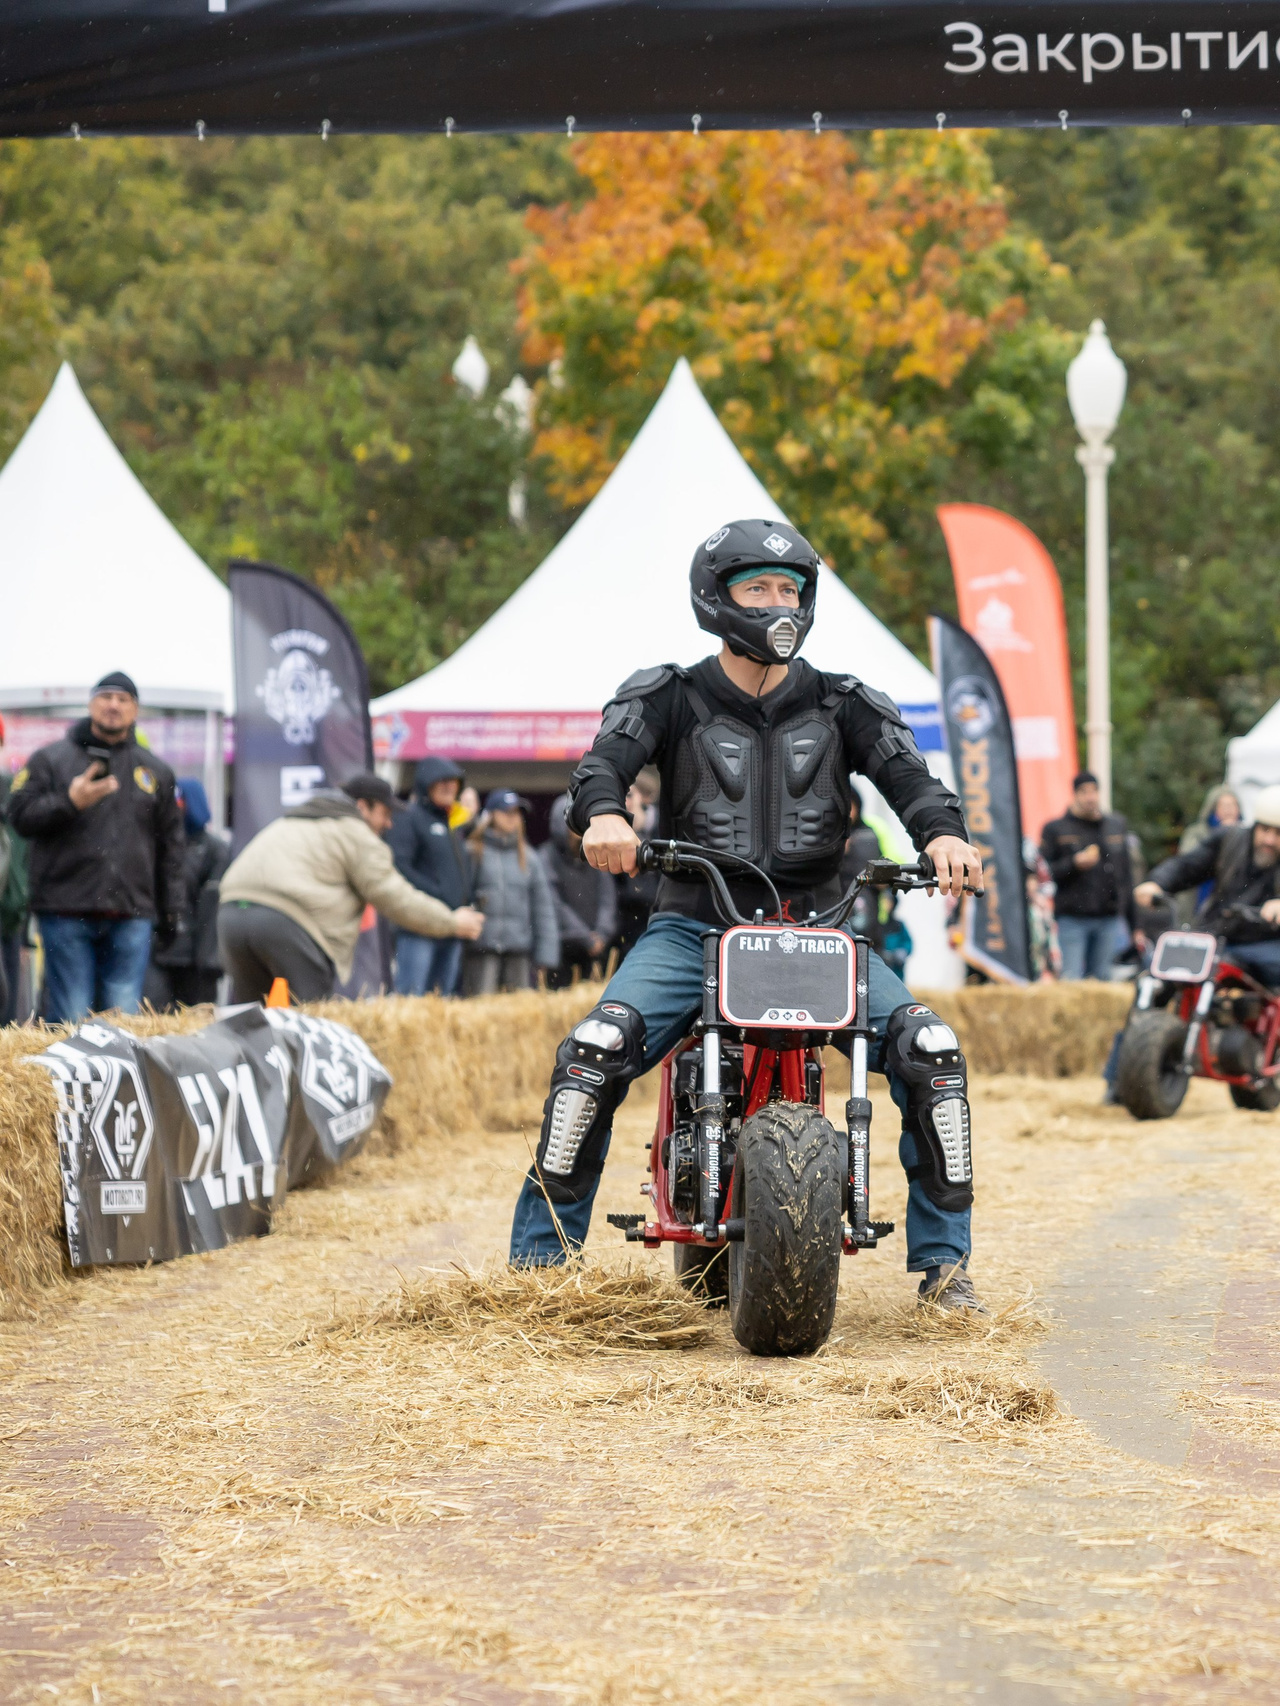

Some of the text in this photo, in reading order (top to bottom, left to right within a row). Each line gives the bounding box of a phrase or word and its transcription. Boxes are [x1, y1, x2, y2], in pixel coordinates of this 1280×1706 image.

[961, 736, 993, 833] DUCK
[739, 936, 845, 954] FLAT TRACK
